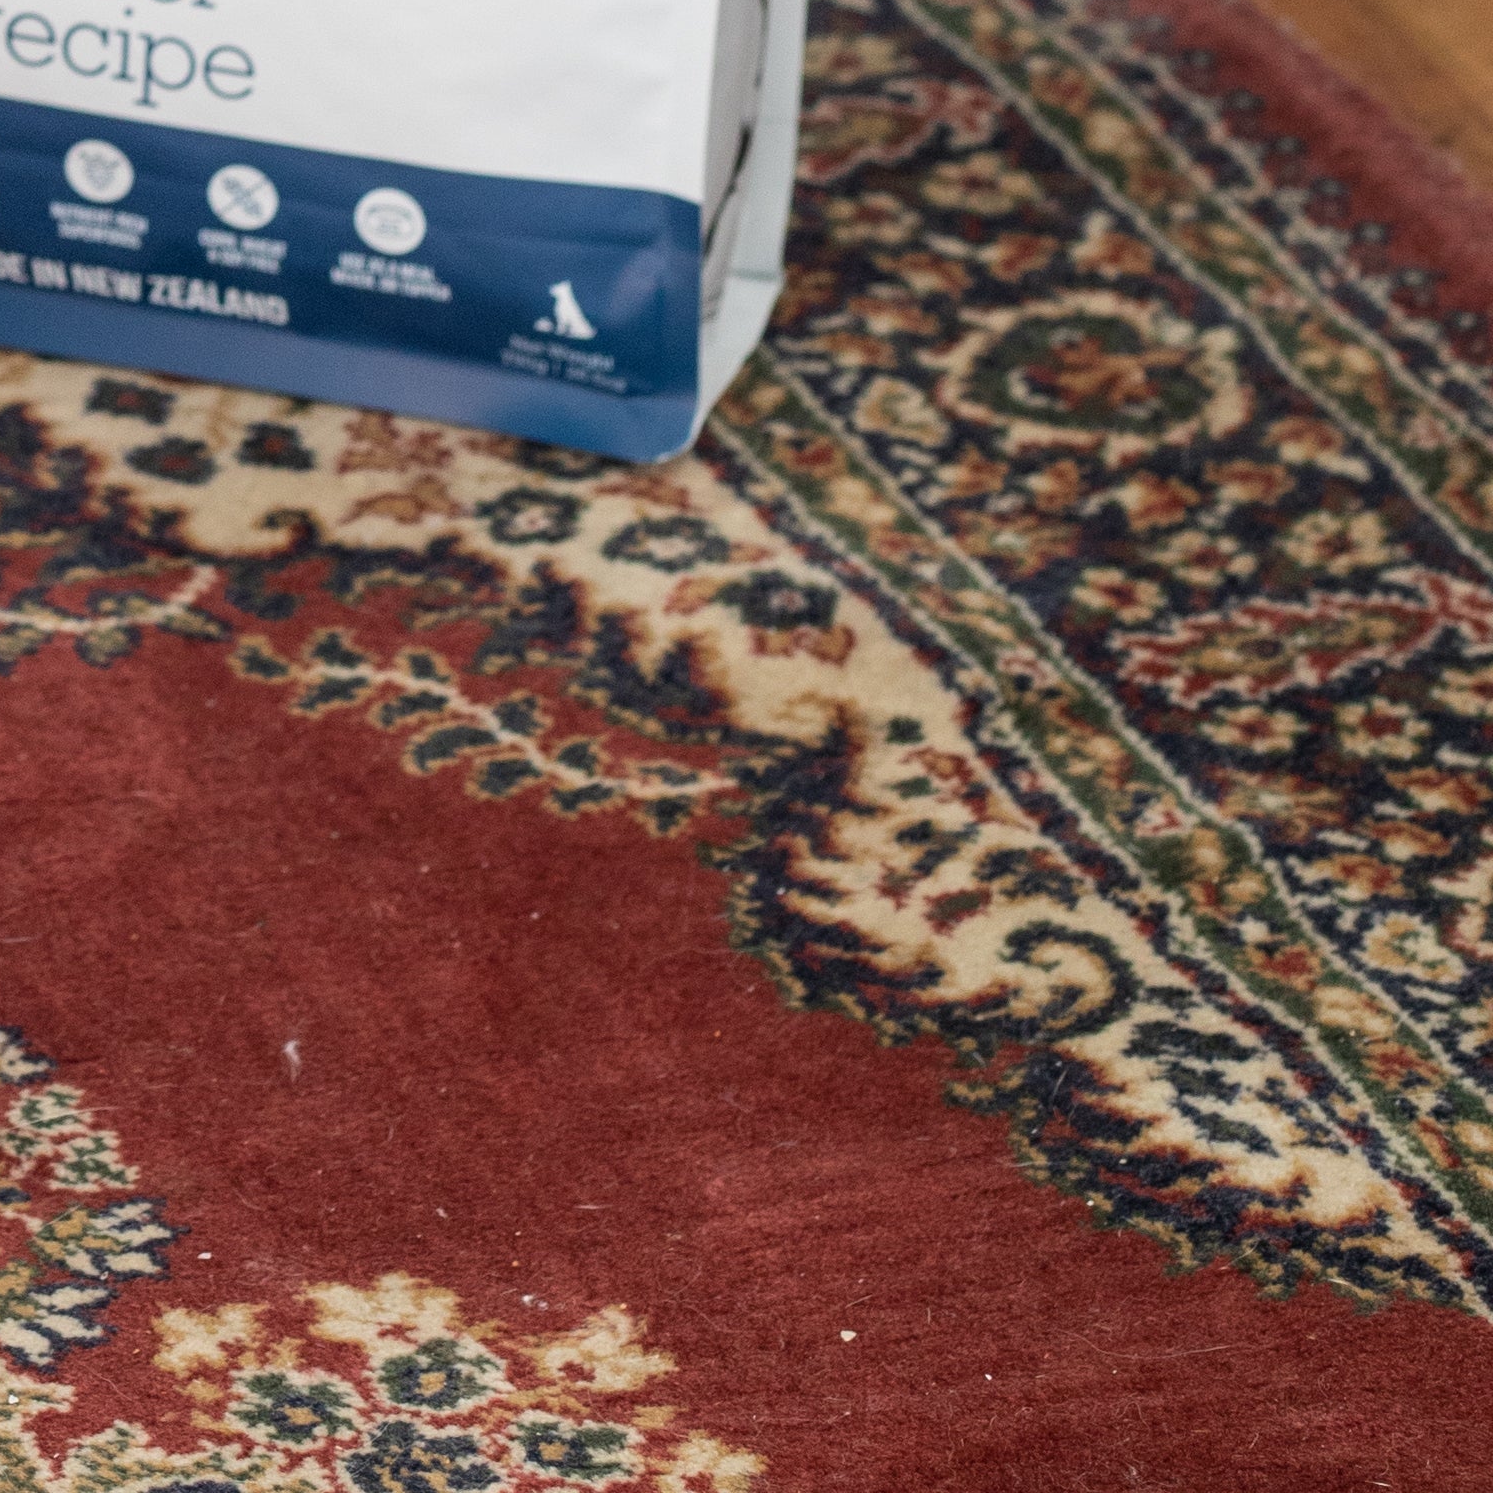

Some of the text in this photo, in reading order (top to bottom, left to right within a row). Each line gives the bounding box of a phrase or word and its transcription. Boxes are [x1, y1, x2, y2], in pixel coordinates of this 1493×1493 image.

[31, 257, 69, 289] IN
[69, 263, 142, 302] NEW
[145, 274, 290, 326] ZEALAND
